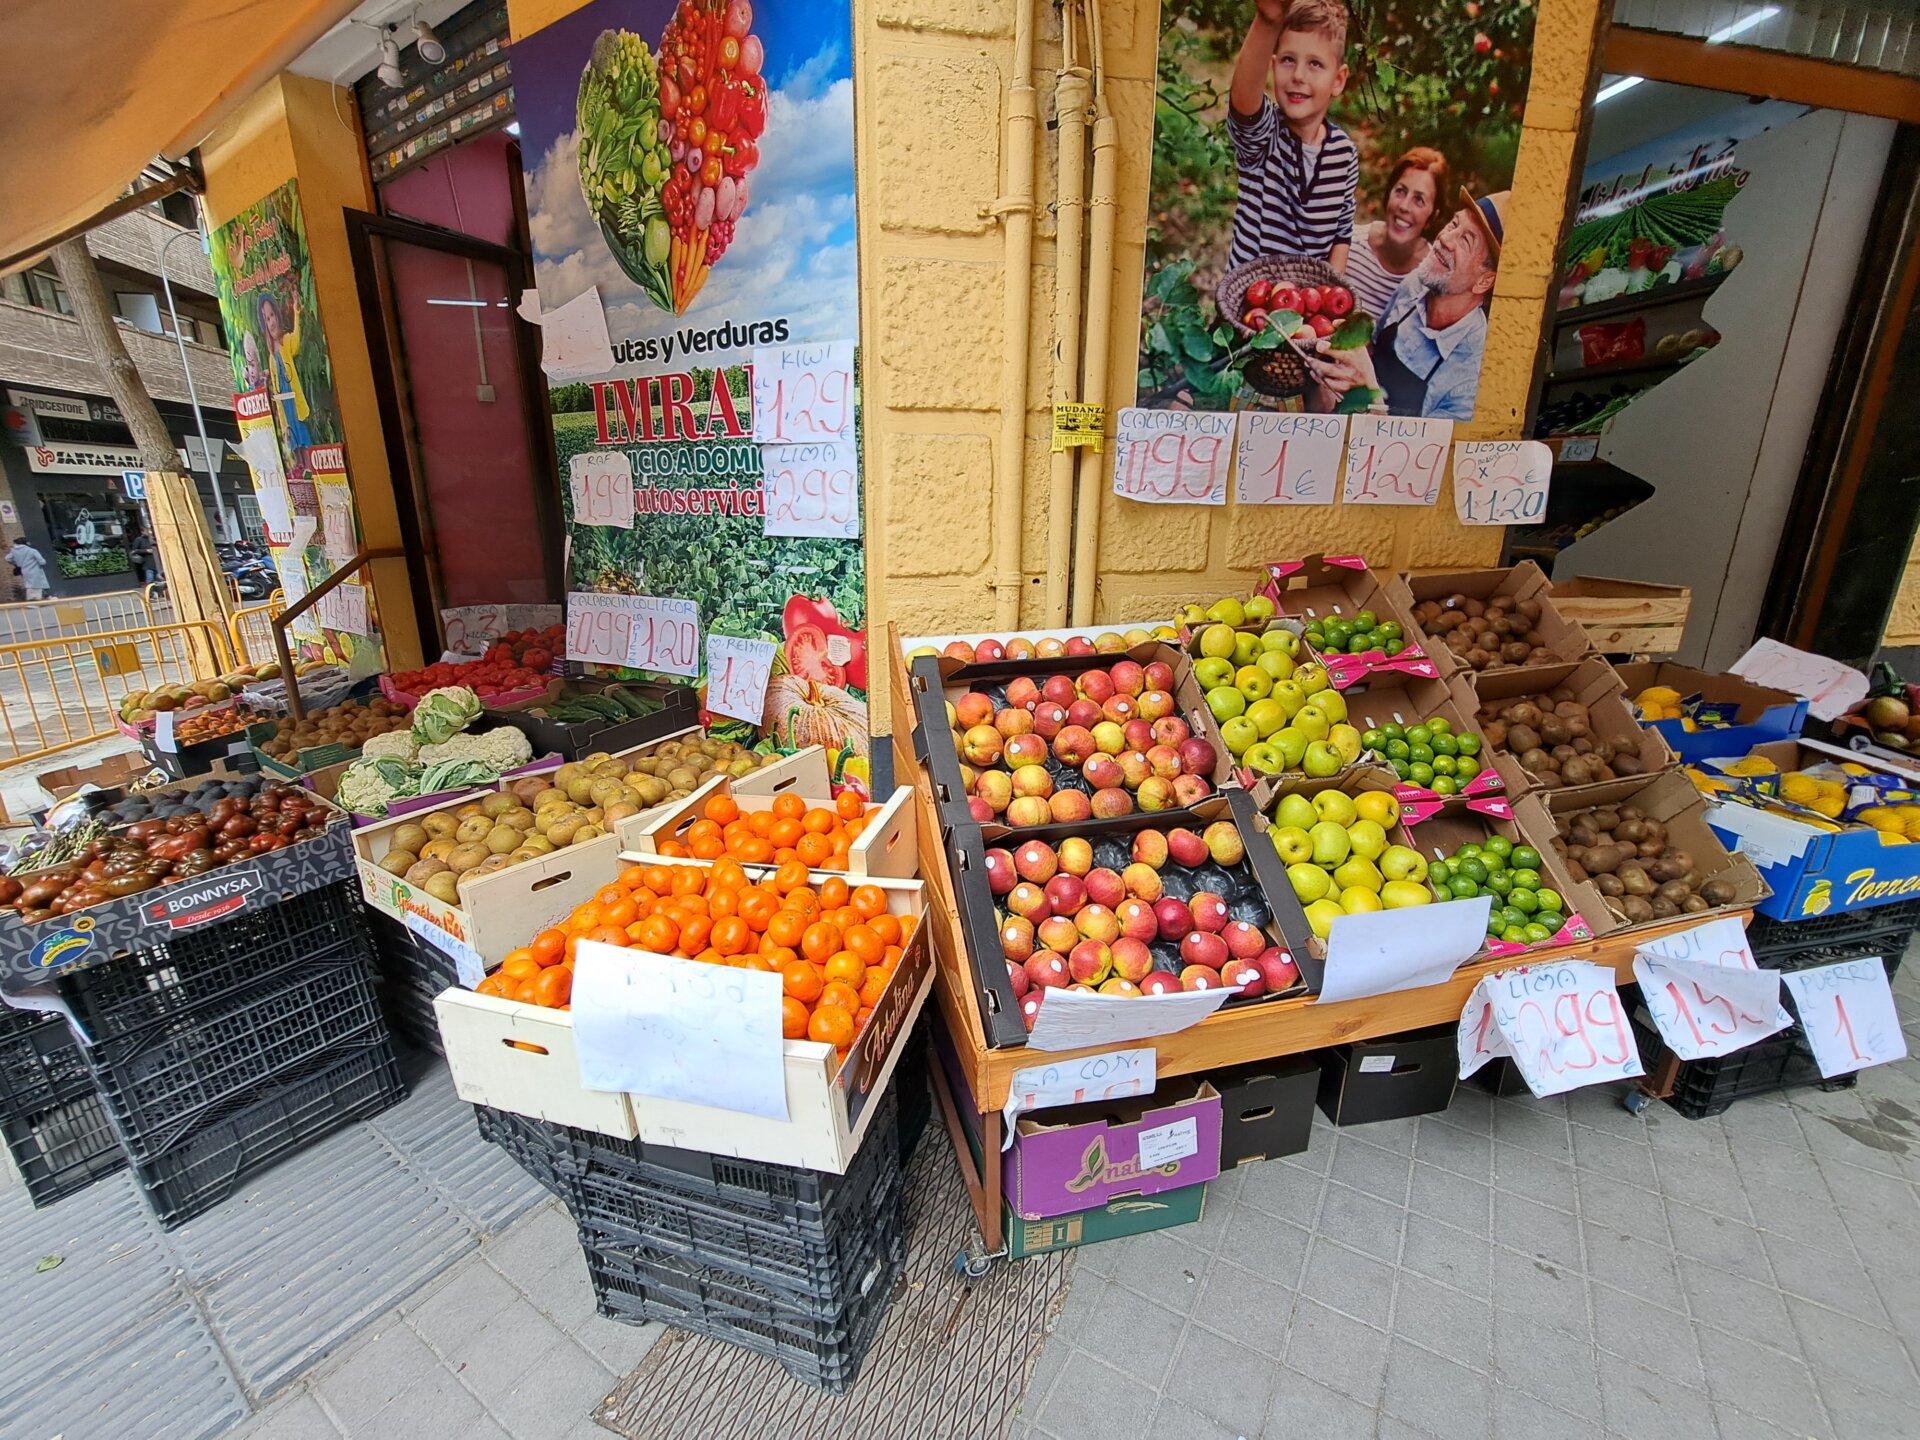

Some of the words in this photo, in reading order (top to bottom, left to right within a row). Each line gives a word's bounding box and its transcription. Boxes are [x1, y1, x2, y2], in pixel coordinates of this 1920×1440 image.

[611, 337, 658, 364] utas
[661, 340, 674, 363] y
[677, 318, 789, 350] Verduras
[783, 343, 832, 371] KIWI
[20, 396, 85, 415] BRIDGESTONE
[1121, 411, 1233, 434] CALABACIN
[1249, 414, 1341, 439] PUERRO
[1375, 420, 1428, 439] KIWI
[311, 448, 344, 470] OFERTA
[780, 444, 836, 463] LIMA
[1465, 442, 1523, 455] LIMON
[677, 450, 694, 474] A
[634, 481, 766, 516] utoservici
[569, 595, 630, 609] CALABACIN
[632, 599, 696, 615] COLIFLOR
[168, 877, 253, 913] BONNYSA
[187, 910, 212, 924] Desde
[1509, 967, 1577, 999] LIMA
[1799, 961, 1878, 993] PUERRO
